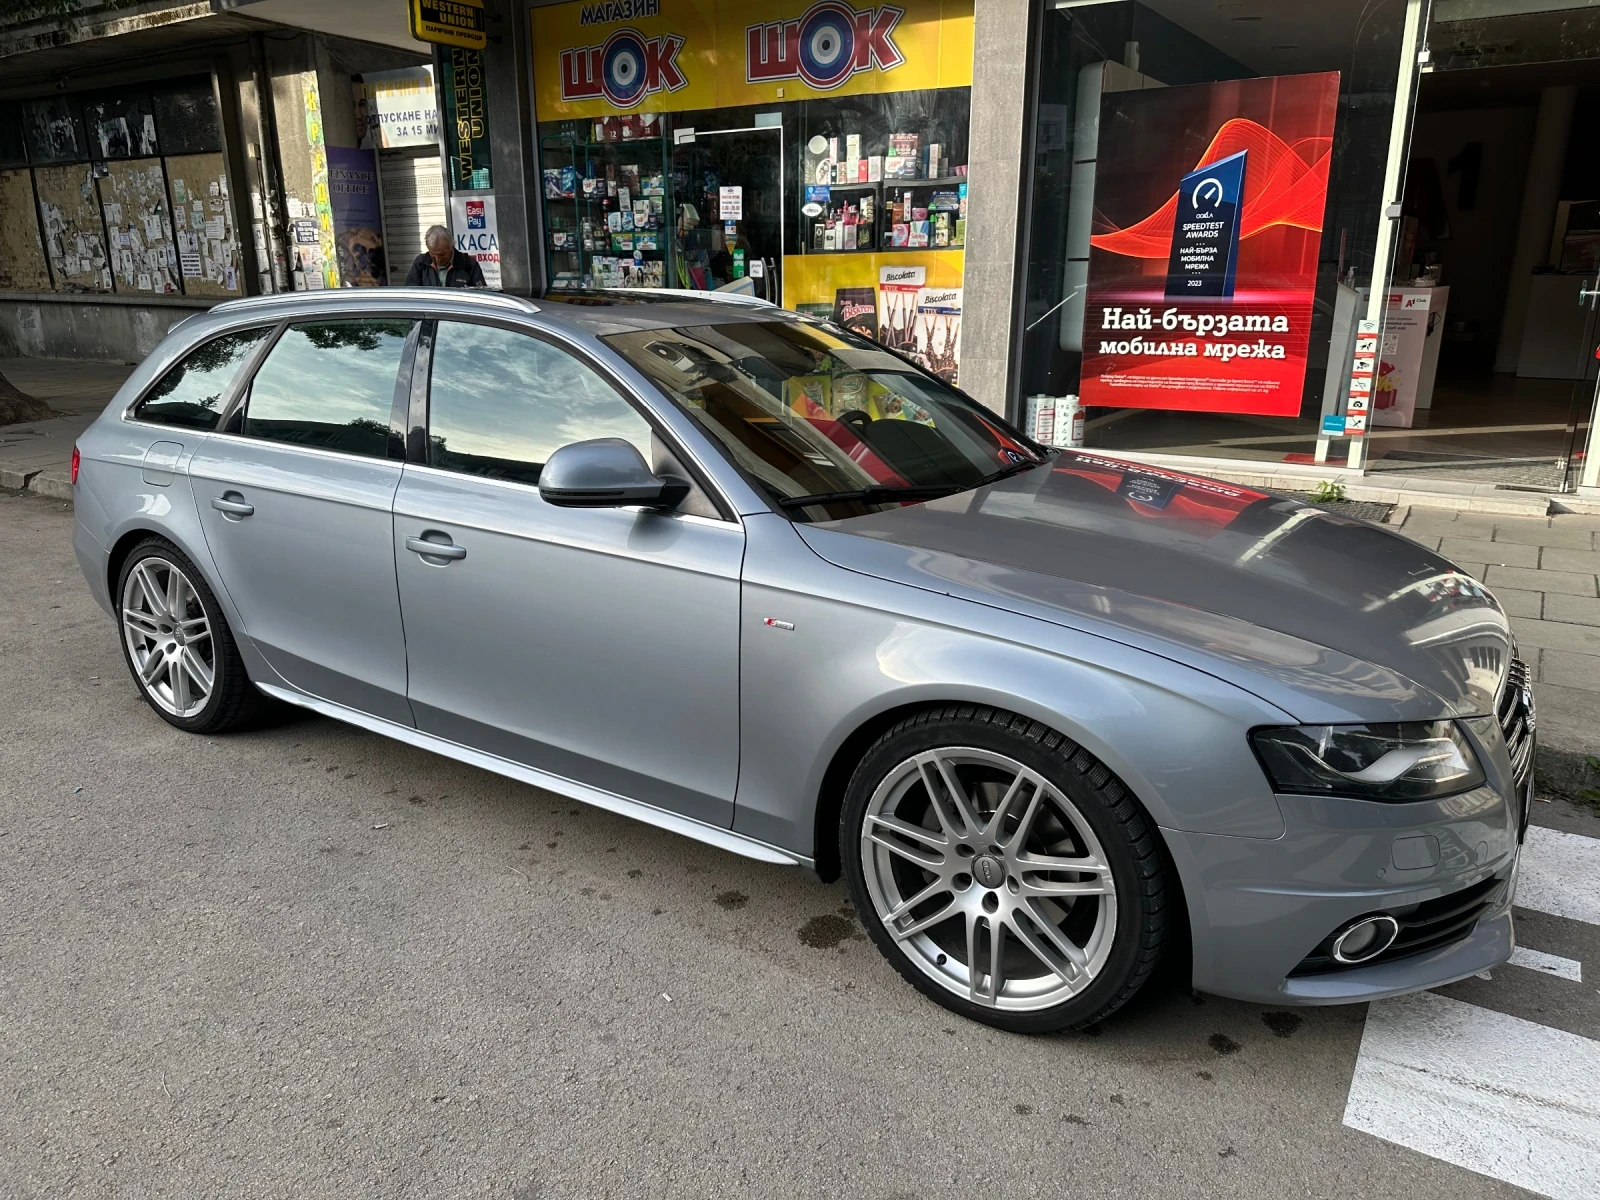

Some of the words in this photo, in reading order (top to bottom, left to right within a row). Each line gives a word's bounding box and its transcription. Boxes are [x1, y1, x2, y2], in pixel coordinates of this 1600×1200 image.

[421, 0, 474, 17] WESTERN
[580, 0, 660, 26] МАГАЗИН
[440, 12, 475, 29] UNION
[746, 0, 905, 91] ШОК
[559, 28, 689, 109] ШОК
[466, 48, 485, 138] UNION
[452, 47, 473, 181] WESTERN
[397, 126, 409, 136] ЗА
[412, 125, 422, 135] 15
[305, 90, 337, 289] КРЕДИТИ
[467, 206, 484, 217] Easy
[468, 216, 482, 227] Pay
[1182, 221, 1224, 231] SPEEDTEST
[457, 233, 499, 251] КАСА
[1186, 230, 1219, 239] AWARDS
[477, 253, 500, 264] ВХОД
[1180, 246, 1218, 254] НАЙ-БЪРЗА
[885, 271, 916, 282] Biscolata
[924, 293, 957, 304] Biscolata
[1405, 298, 1416, 308] A1
[841, 303, 875, 321] Biskrem
[1101, 307, 1289, 336] Най-бързата
[1099, 336, 1198, 356] мобилна
[1203, 339, 1286, 362] мрежа
